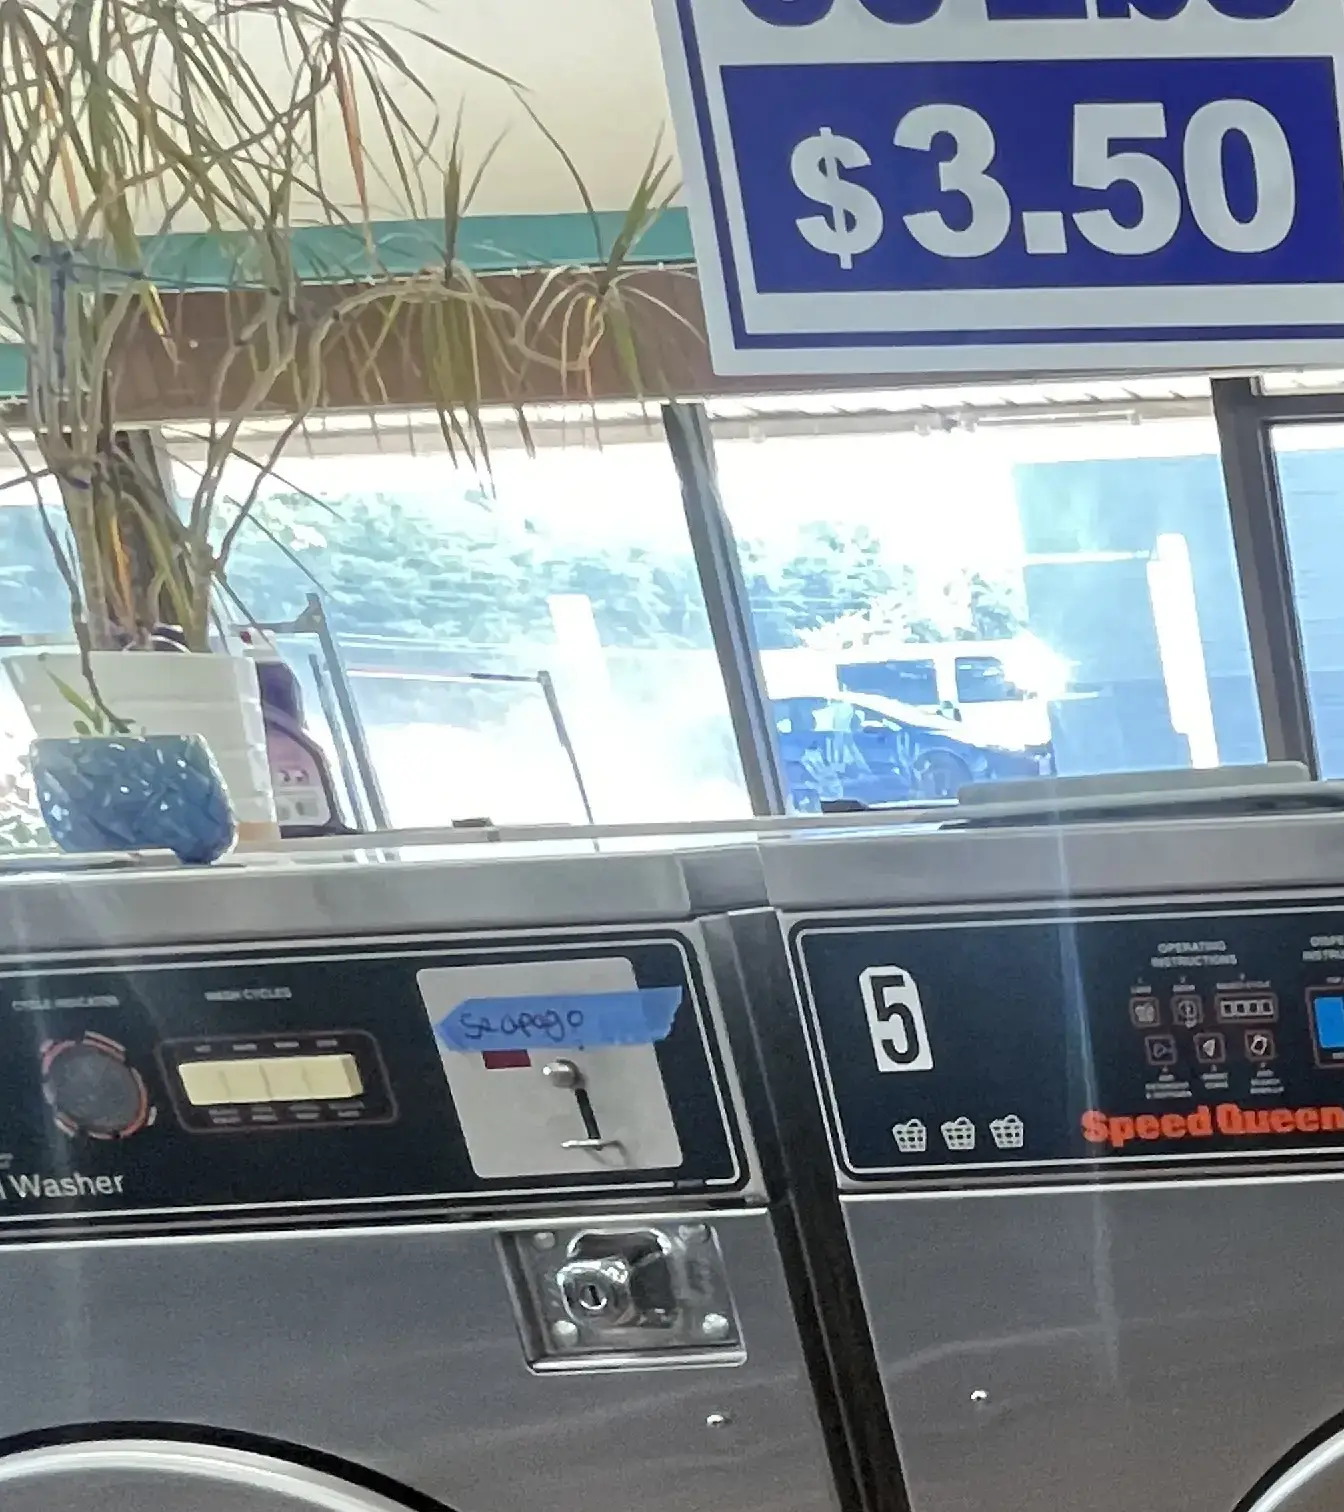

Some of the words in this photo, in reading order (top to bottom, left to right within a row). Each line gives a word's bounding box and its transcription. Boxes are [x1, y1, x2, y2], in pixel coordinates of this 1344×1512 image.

[790, 99, 1296, 269] $3.50
[869, 974, 920, 1064] 5
[1081, 1105, 1211, 1148] Speed
[8, 1172, 125, 1199] Washer
